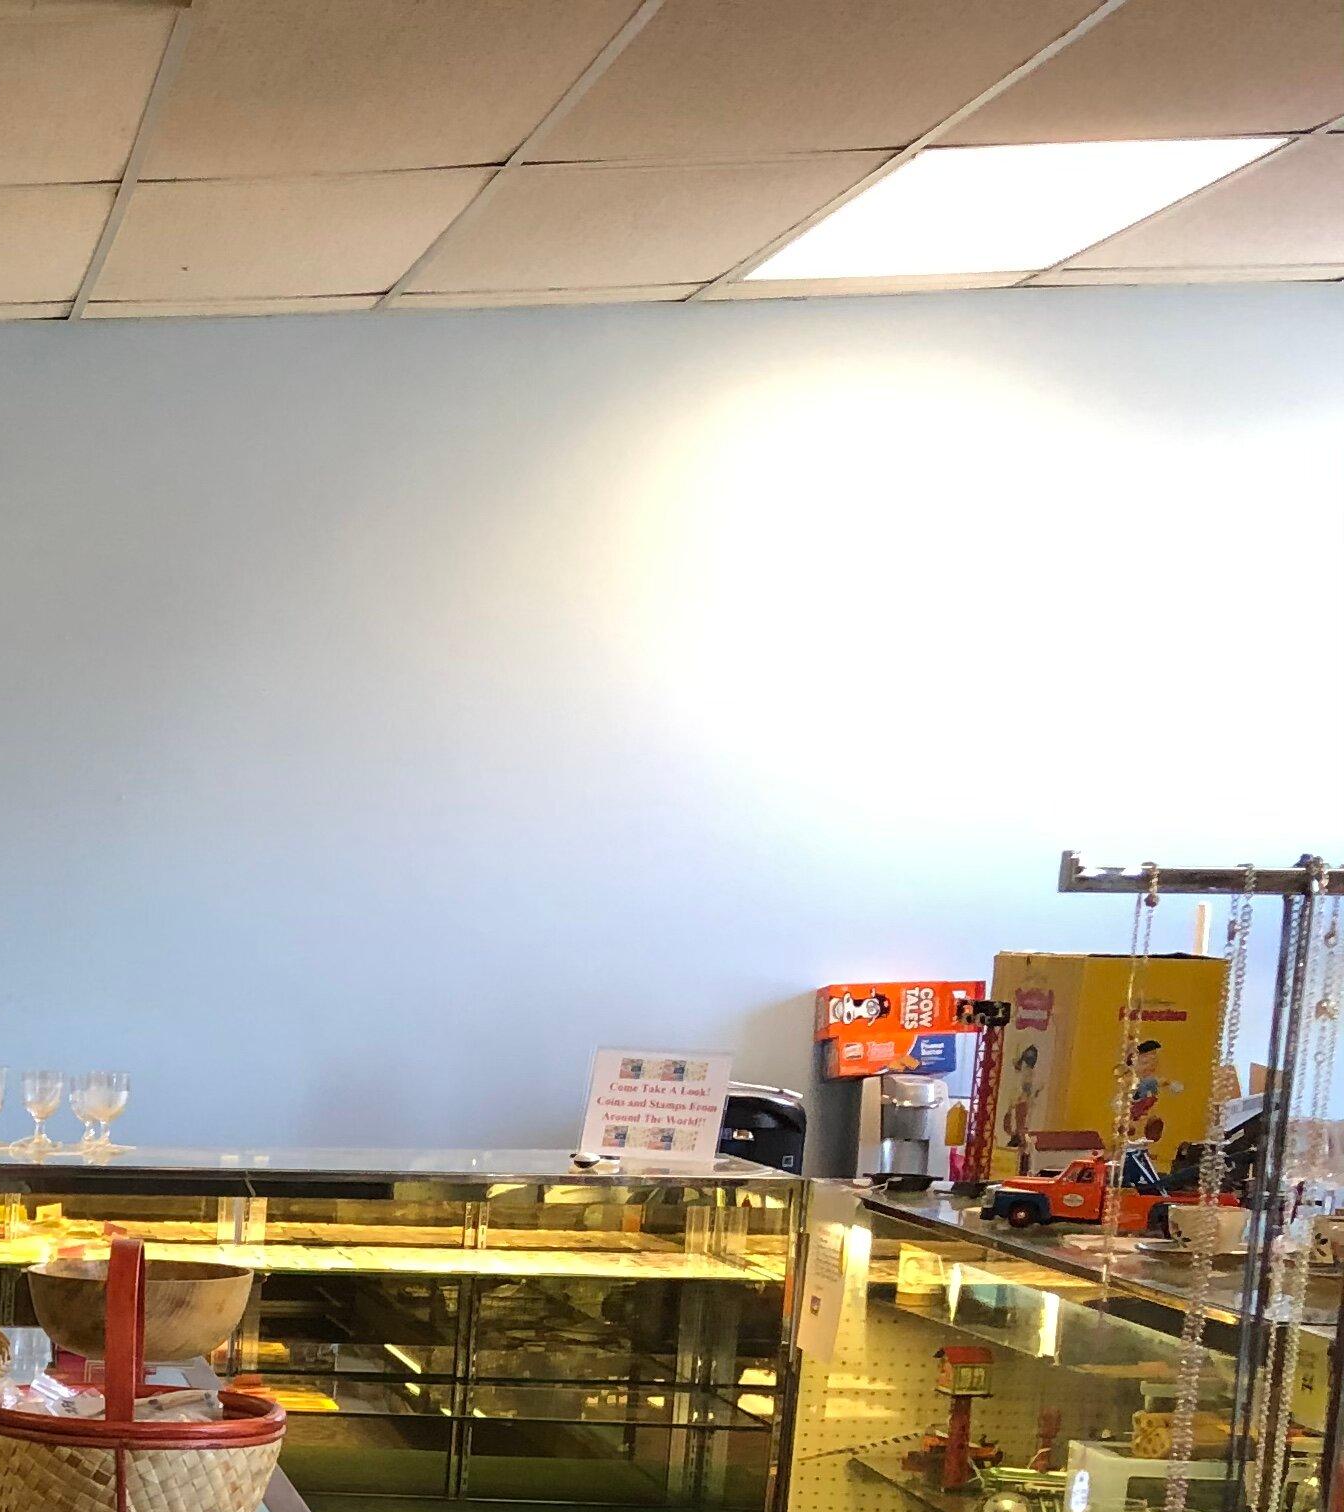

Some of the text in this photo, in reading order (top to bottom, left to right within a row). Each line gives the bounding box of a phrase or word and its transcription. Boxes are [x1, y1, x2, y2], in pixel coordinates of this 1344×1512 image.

[905, 987, 920, 1030] TALES
[919, 987, 934, 1028] COW
[609, 1082, 638, 1093] Come
[642, 1084, 667, 1094] Take
[670, 1086, 677, 1095] A
[596, 1096, 625, 1106] Coins
[627, 1099, 647, 1108] and
[650, 1099, 686, 1111] Stamps
[602, 1112, 641, 1123] Around
[645, 1113, 662, 1124] The
